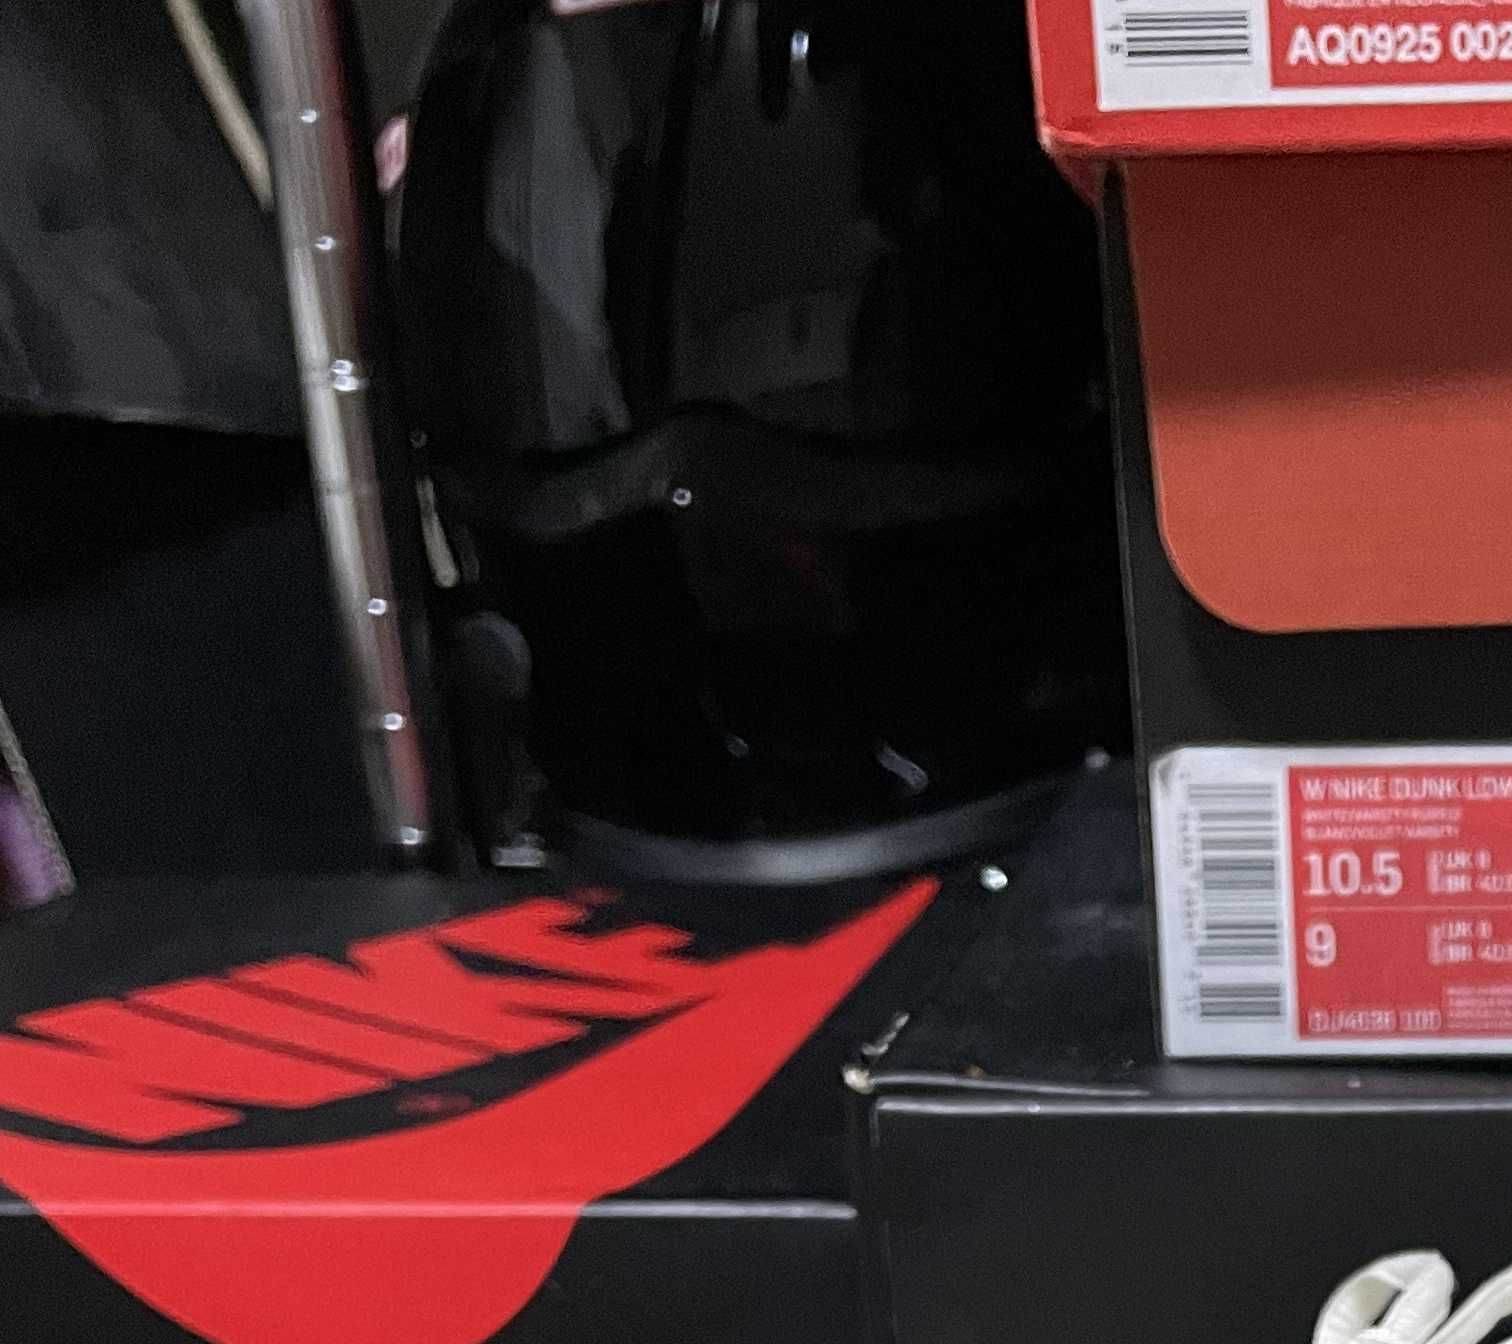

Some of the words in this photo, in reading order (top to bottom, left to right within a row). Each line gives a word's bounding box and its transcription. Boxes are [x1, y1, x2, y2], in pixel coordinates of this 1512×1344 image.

[1287, 25, 1441, 65] AQ0925
[1327, 776, 1387, 801] NIKE
[1389, 776, 1461, 801] DUNK
[1303, 850, 1404, 896] 10.5
[1304, 922, 1339, 969] 9
[0, 897, 708, 1144] NIKE
